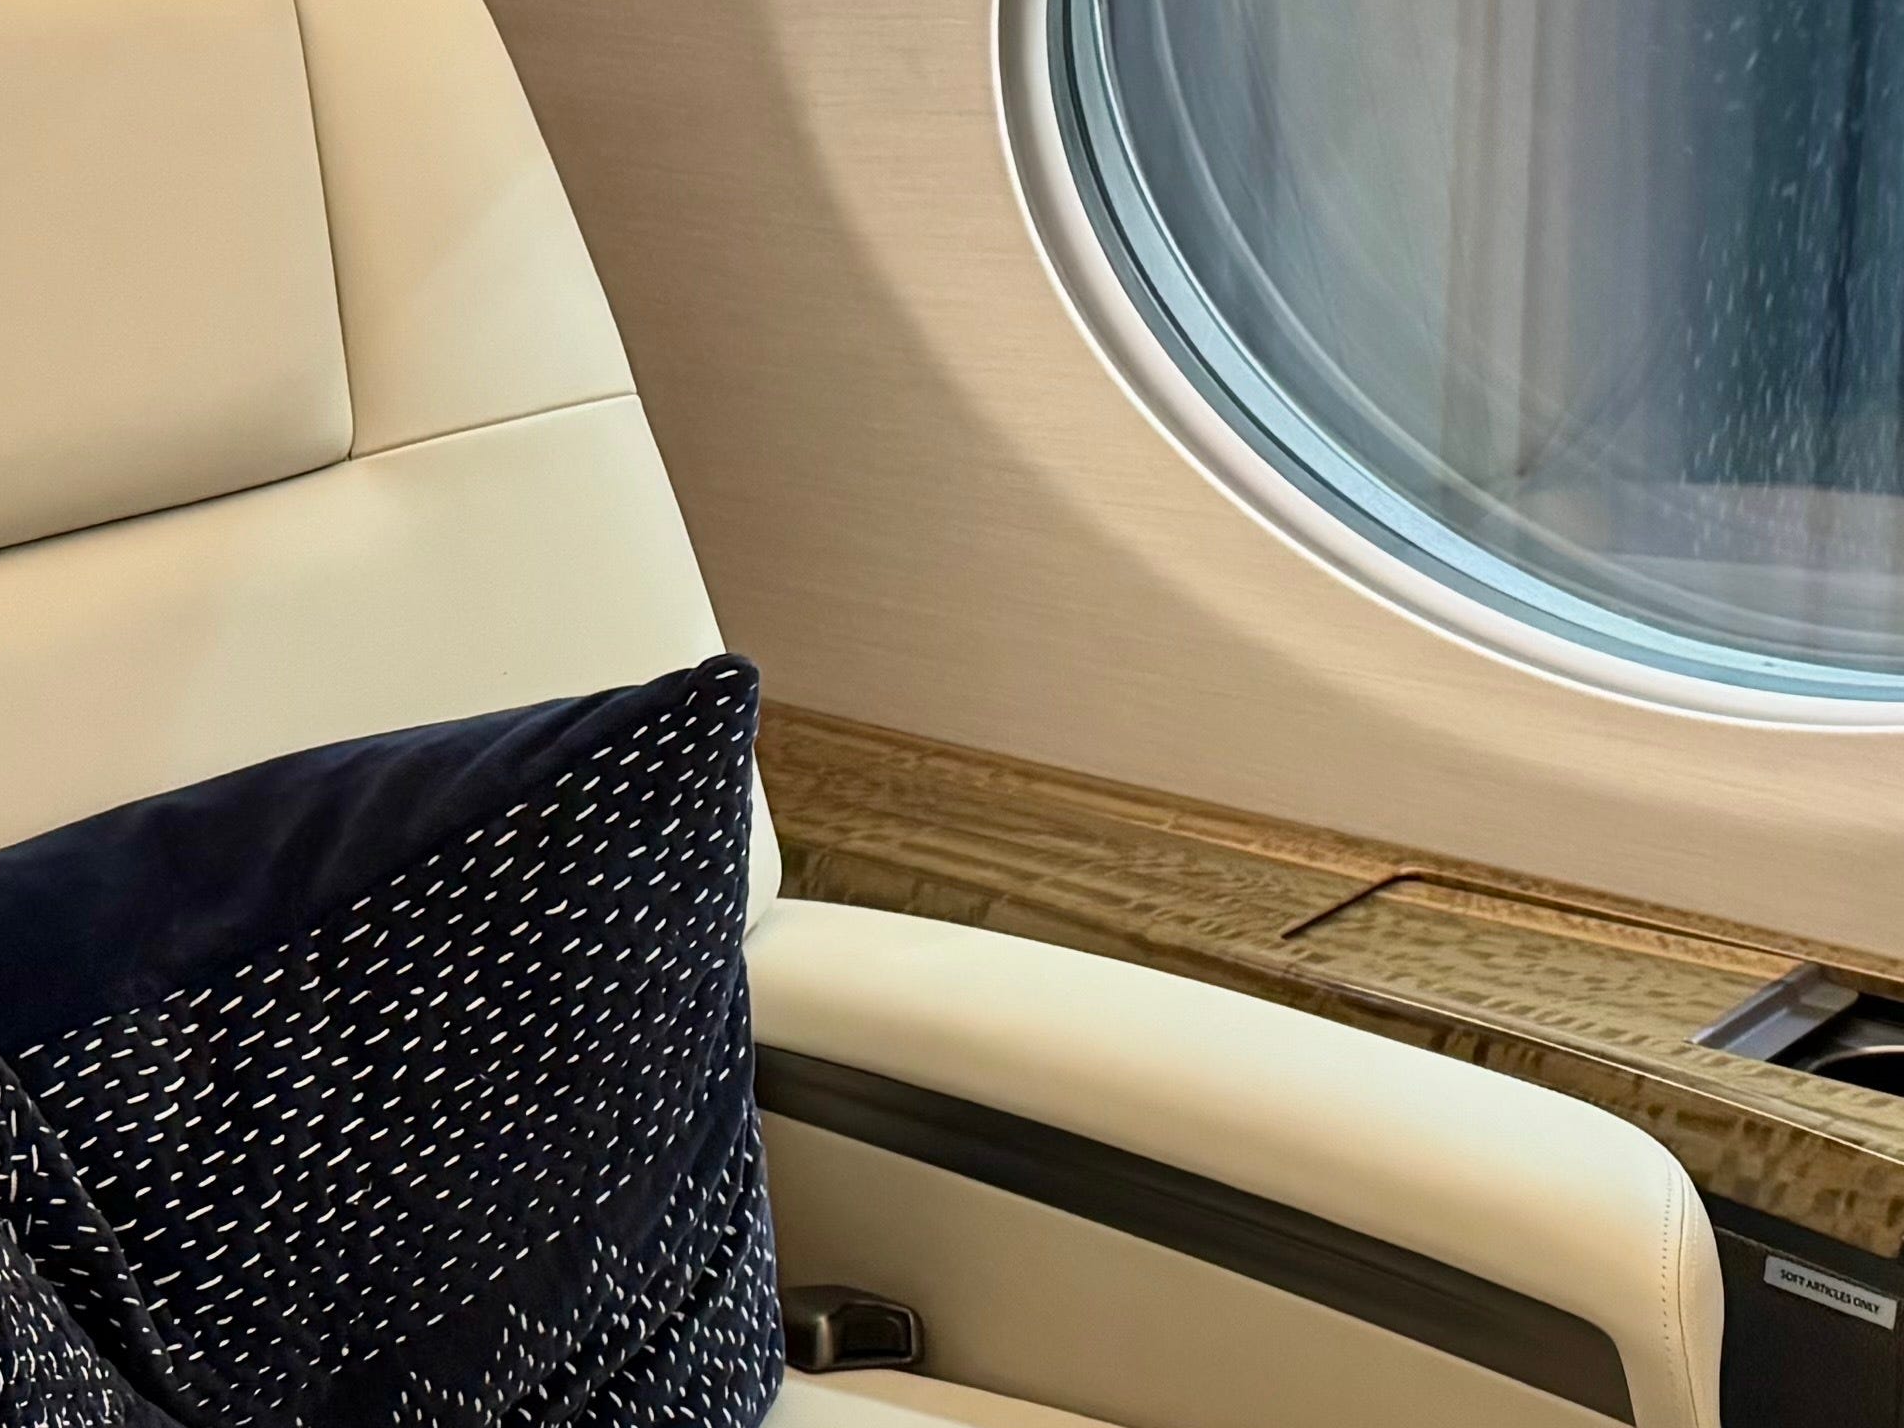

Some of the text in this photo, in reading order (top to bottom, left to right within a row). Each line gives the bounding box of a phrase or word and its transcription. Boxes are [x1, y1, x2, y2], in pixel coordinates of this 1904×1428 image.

[1780, 1269, 1879, 1314] SOFT ARTICLES ONLY
